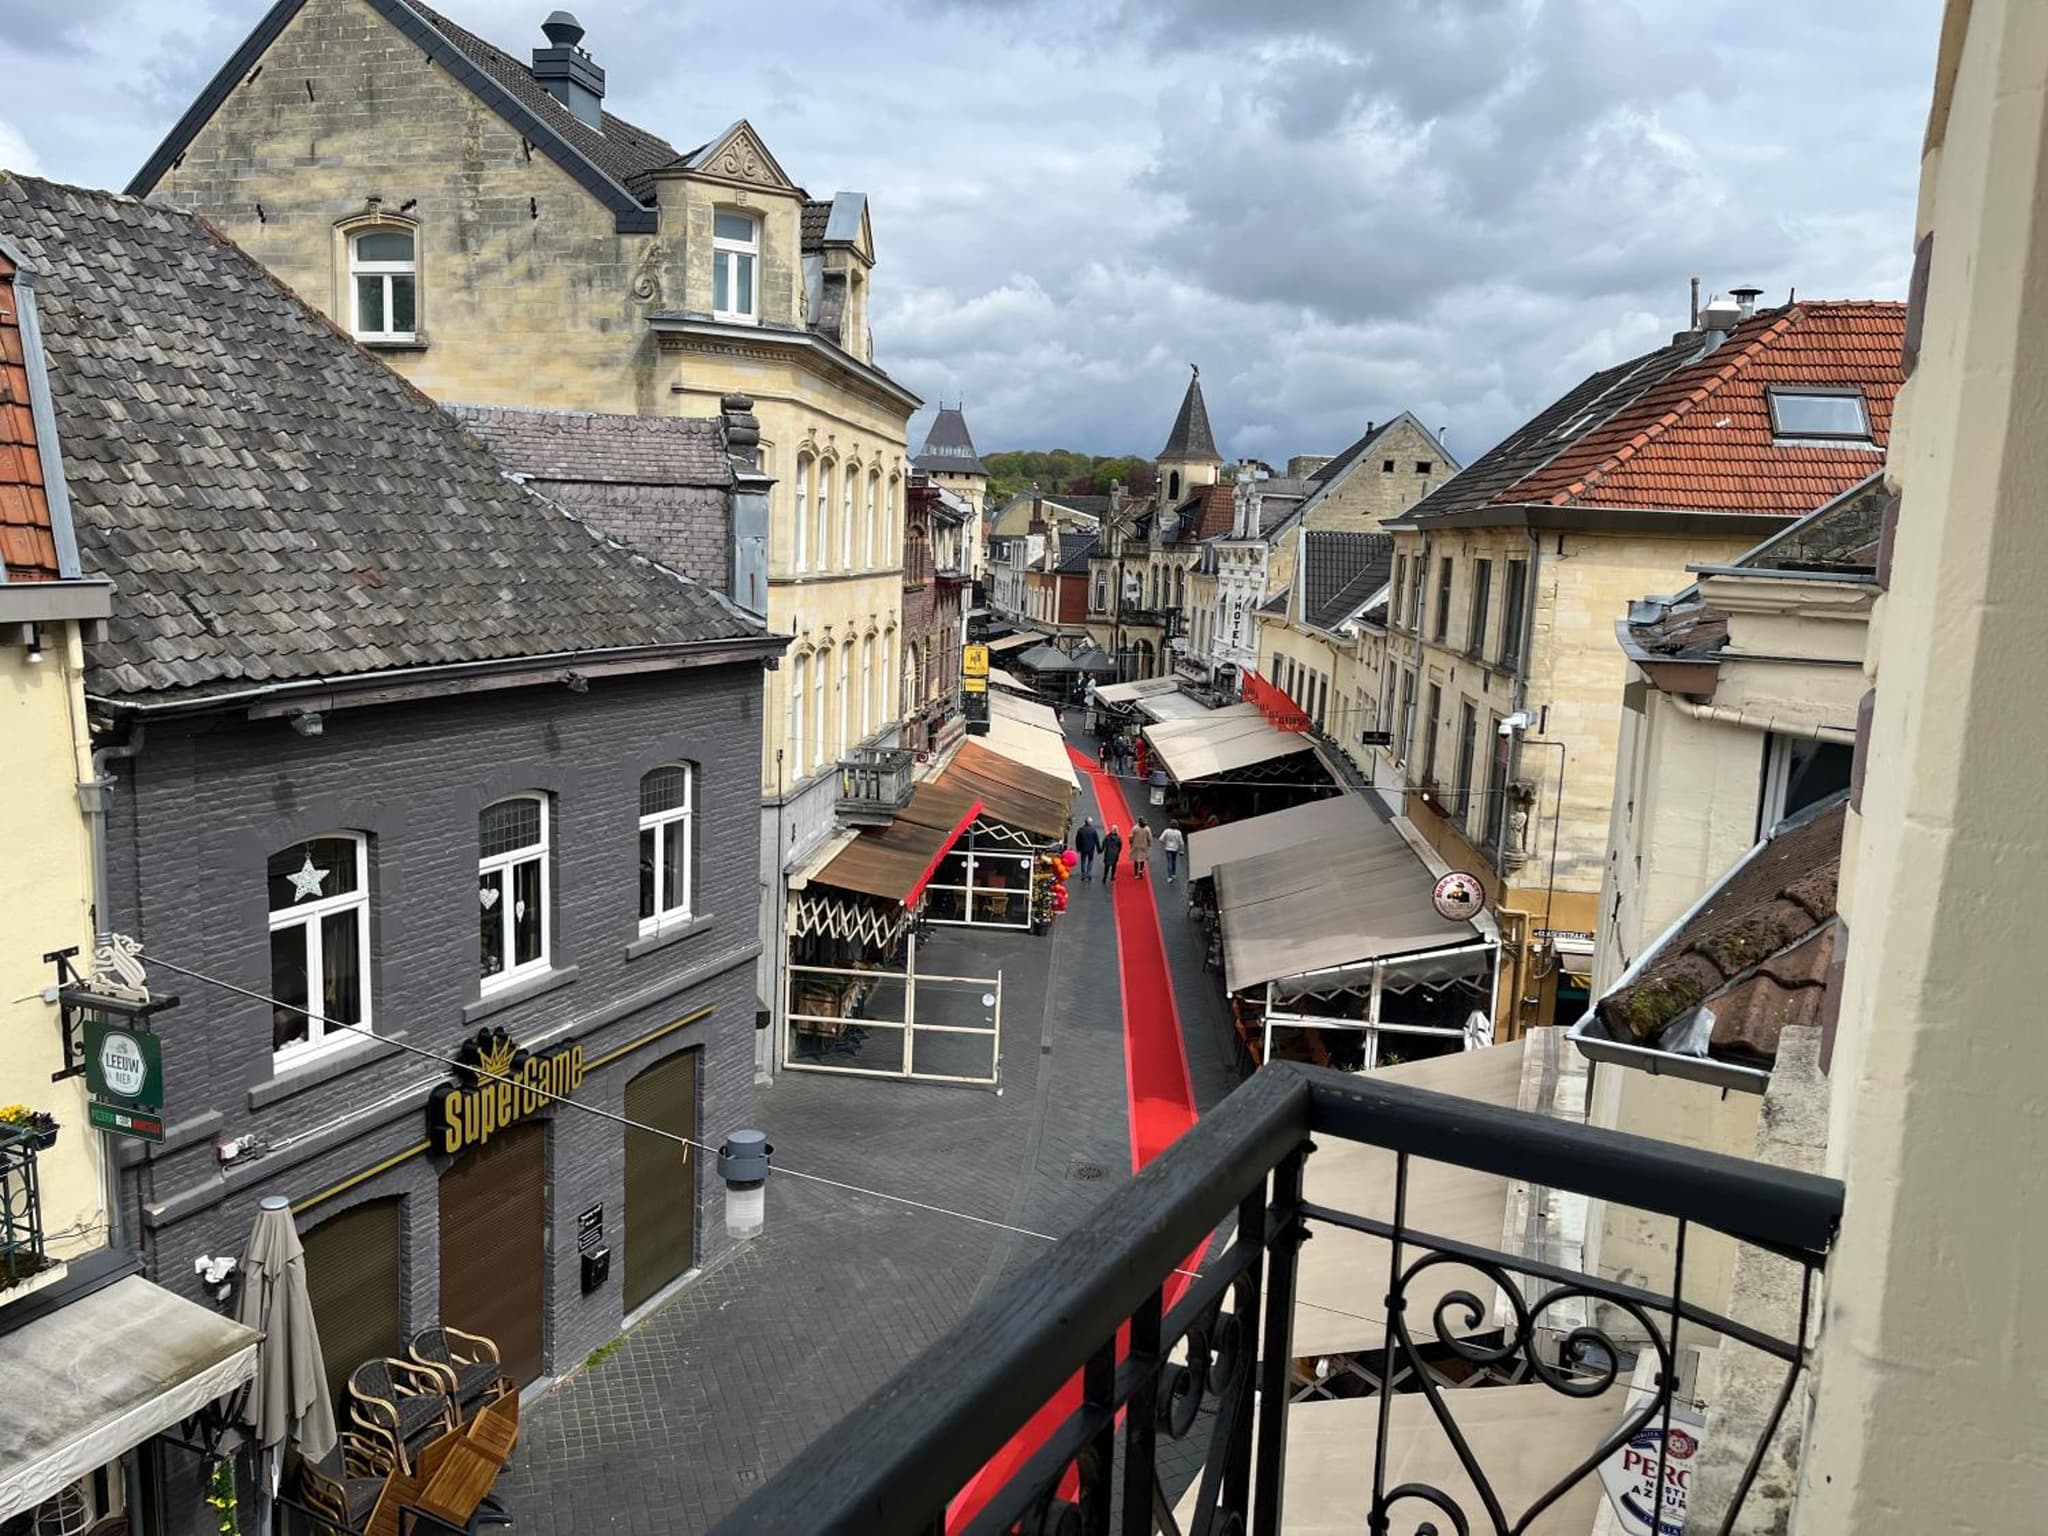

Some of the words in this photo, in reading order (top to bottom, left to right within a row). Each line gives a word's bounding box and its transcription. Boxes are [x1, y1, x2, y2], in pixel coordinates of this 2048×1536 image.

[1232, 601, 1242, 649] HOTEL
[105, 1052, 140, 1074] LEEUW
[1631, 1484, 1687, 1510] AZUR
